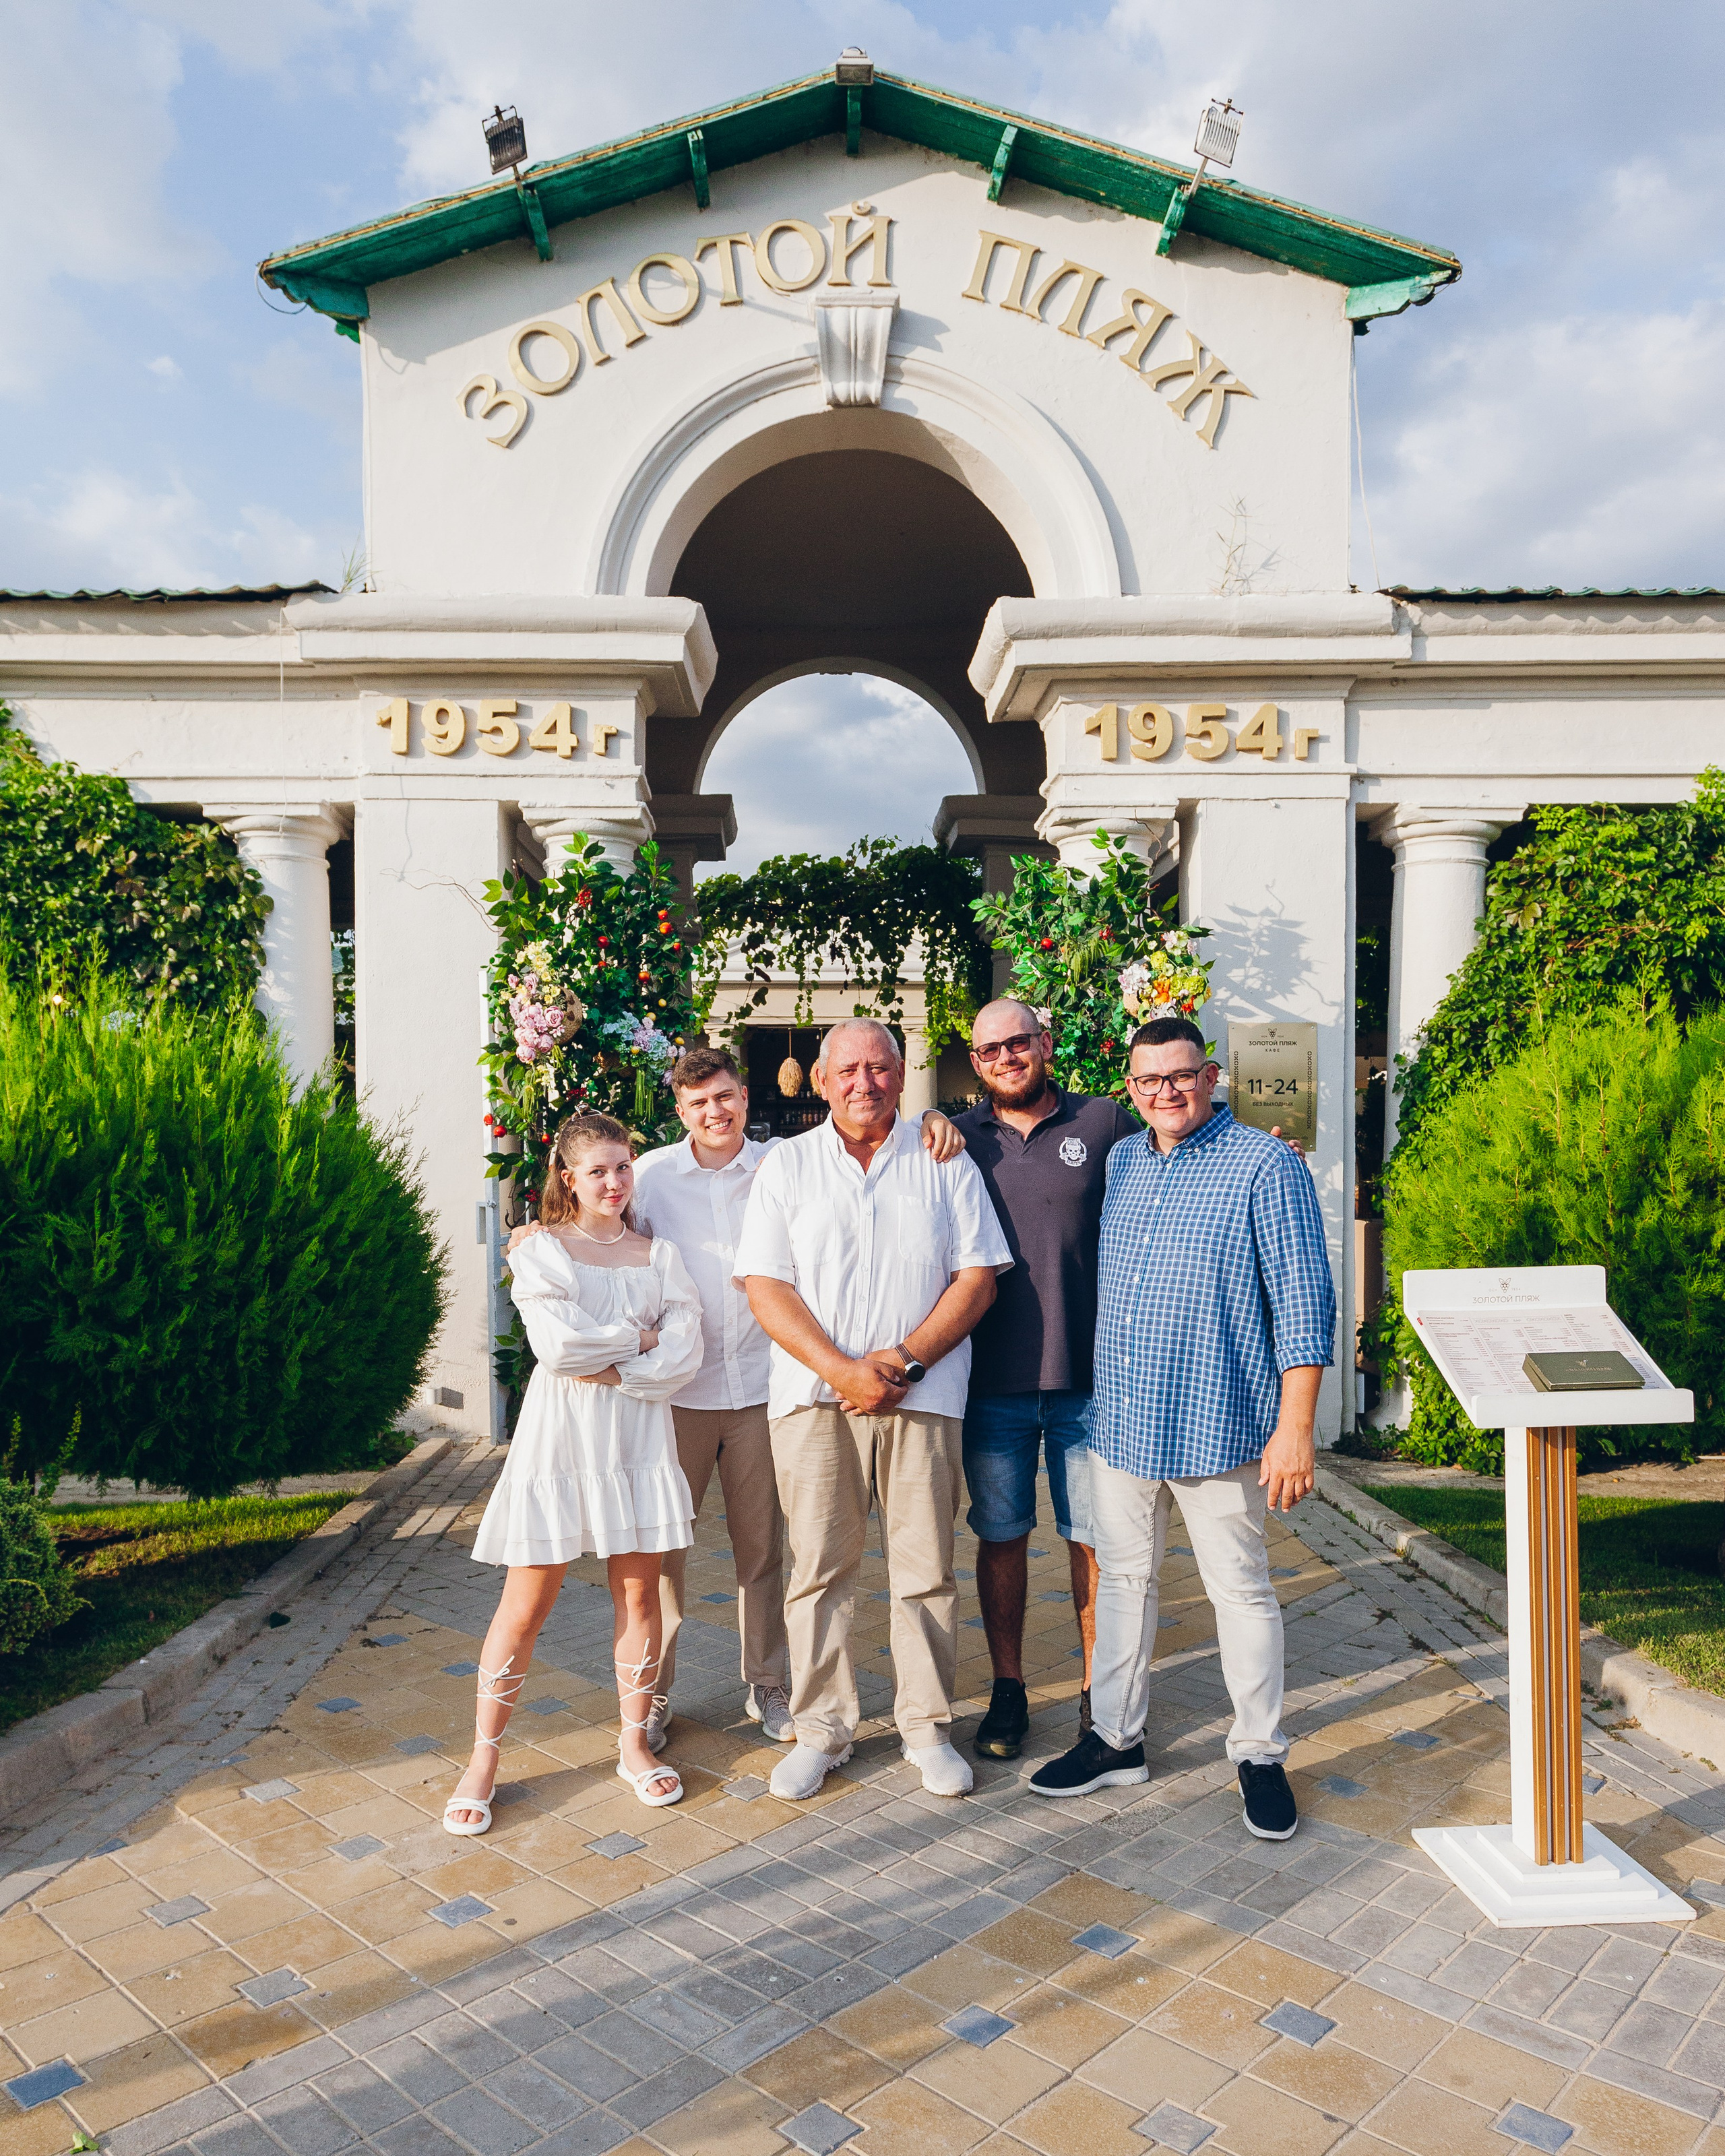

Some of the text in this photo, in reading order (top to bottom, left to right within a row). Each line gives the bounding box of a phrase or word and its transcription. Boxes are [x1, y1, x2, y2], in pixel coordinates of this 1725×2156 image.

[456, 201, 1255, 449] ЗОЛОТОЙ ПЛЯЖ
[1247, 1079, 1298, 1095] 11-24
[1472, 1294, 1513, 1304] ЗОЛОТОЙ
